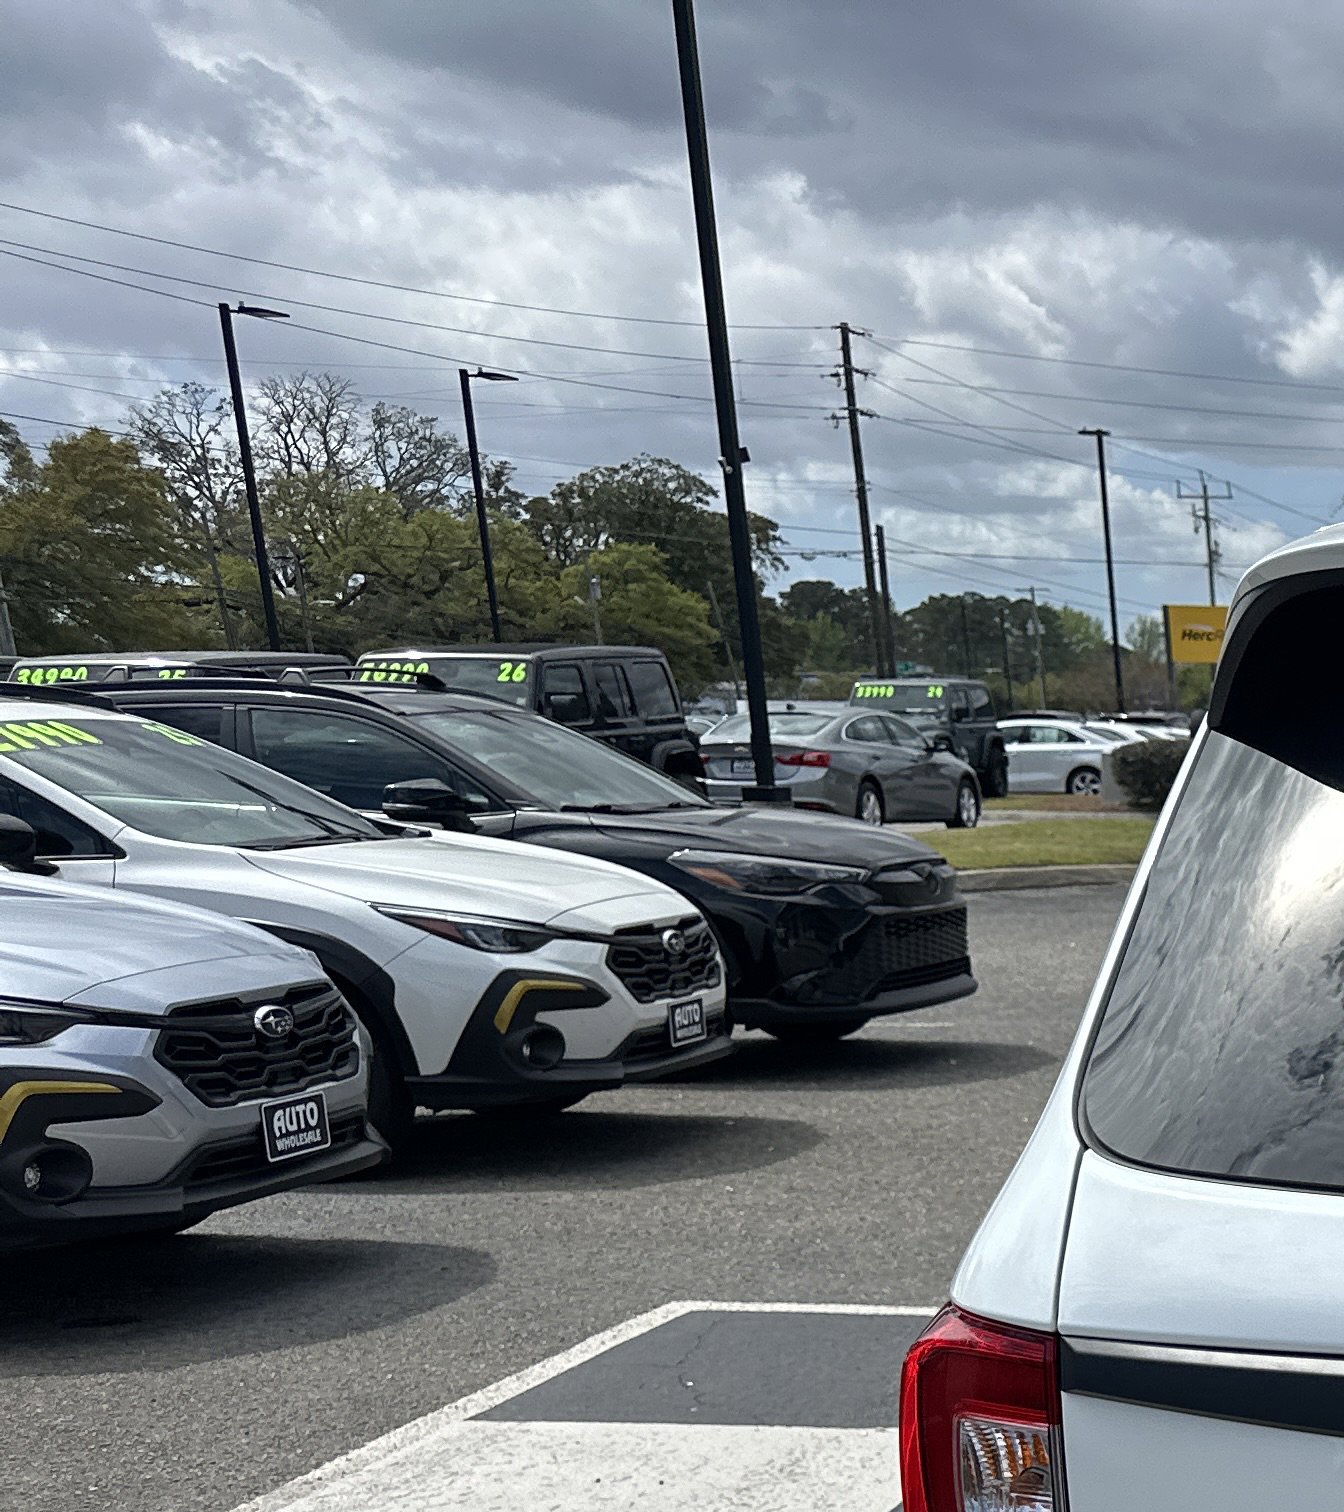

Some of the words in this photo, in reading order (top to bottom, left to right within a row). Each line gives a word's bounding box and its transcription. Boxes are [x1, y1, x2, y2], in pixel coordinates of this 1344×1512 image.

[497, 662, 527, 682] 26
[273, 1101, 319, 1137] AUTO
[275, 1128, 322, 1152] WHOLESALE
